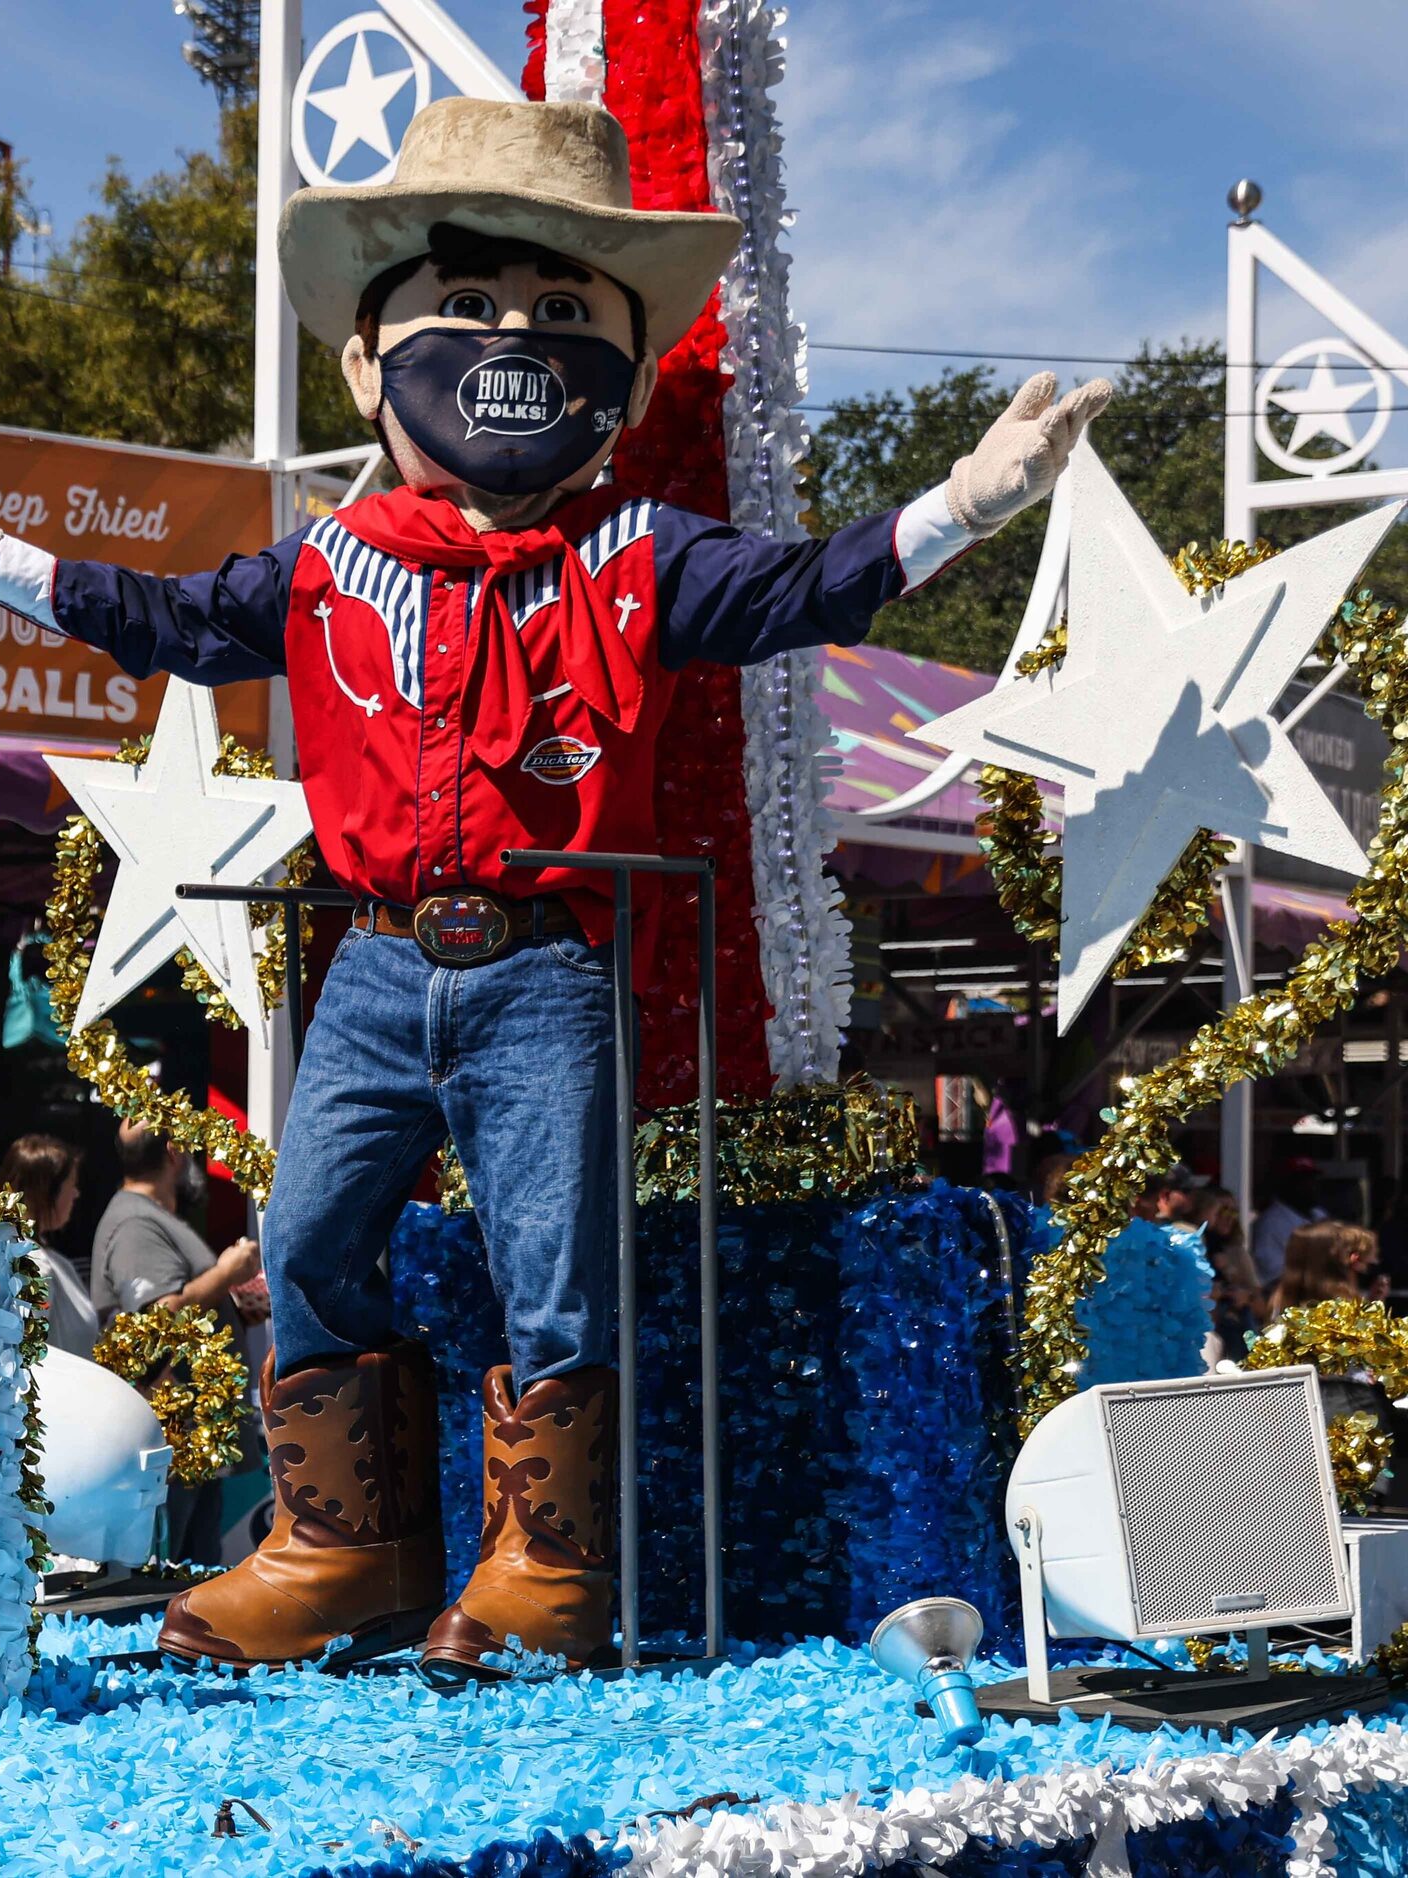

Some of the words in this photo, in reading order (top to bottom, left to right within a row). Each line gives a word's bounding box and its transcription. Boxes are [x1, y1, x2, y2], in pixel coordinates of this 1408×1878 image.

[476, 370, 551, 403] HOWDY
[474, 403, 548, 421] FOLKS!
[64, 484, 170, 542] Fried
[530, 755, 589, 766] Dickies
